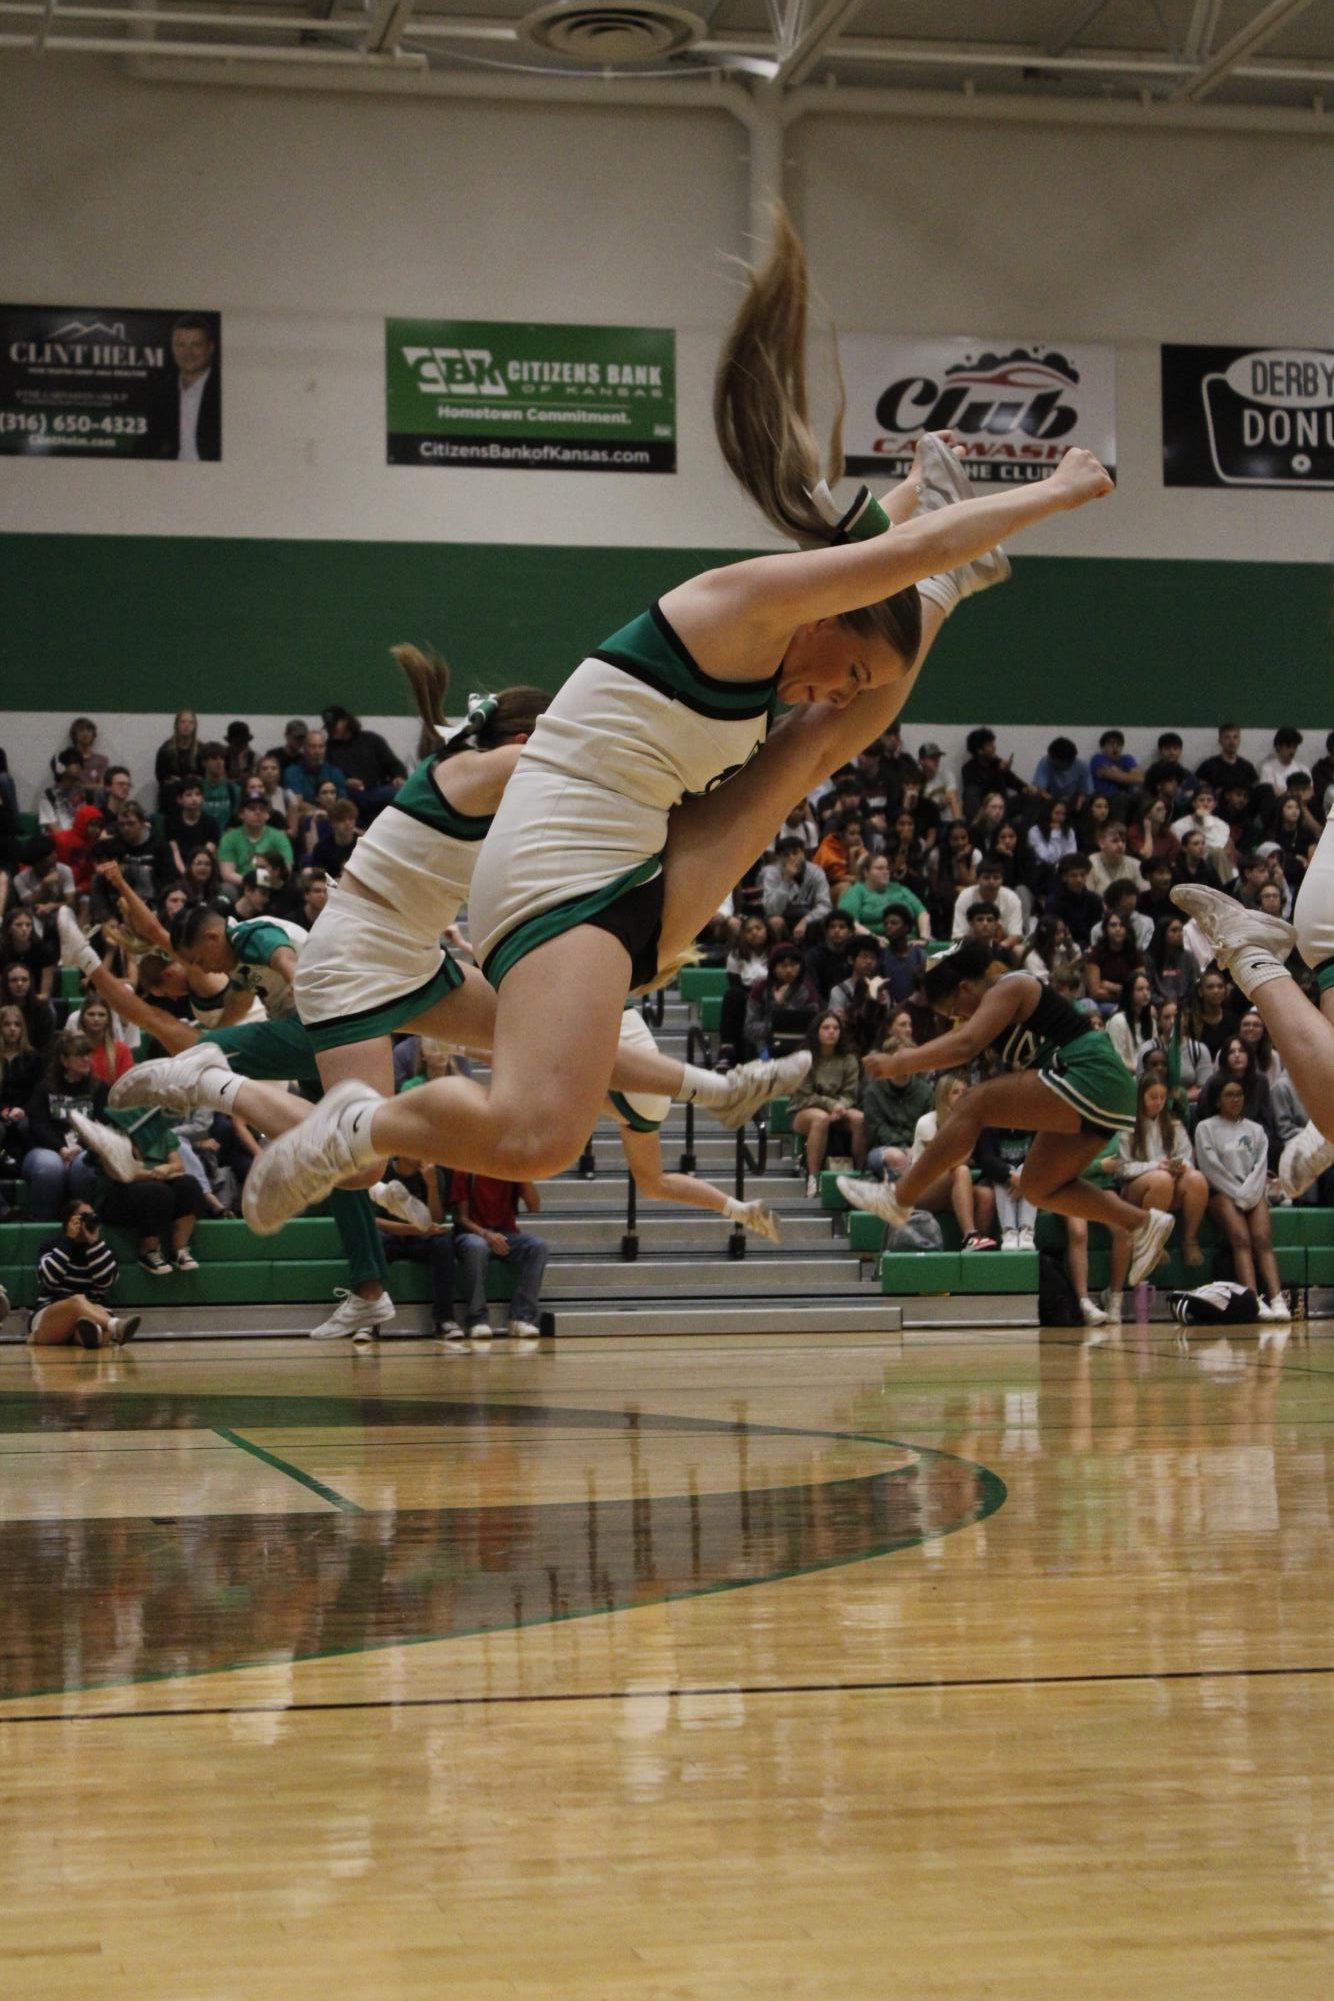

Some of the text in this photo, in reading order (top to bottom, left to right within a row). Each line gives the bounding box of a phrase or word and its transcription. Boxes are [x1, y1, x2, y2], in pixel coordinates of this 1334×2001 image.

[9, 341, 164, 368] CLINT HELM
[507, 360, 662, 387] CITIZENS BANK
[1251, 359, 1334, 398] DERBY
[521, 384, 664, 398] OF KANSAS
[437, 404, 632, 425] Hometown Commitment.
[876, 376, 1079, 439] Club
[0, 411, 147, 434] (316) 650-4323
[420, 441, 650, 464] CitizensBankofKansas.com
